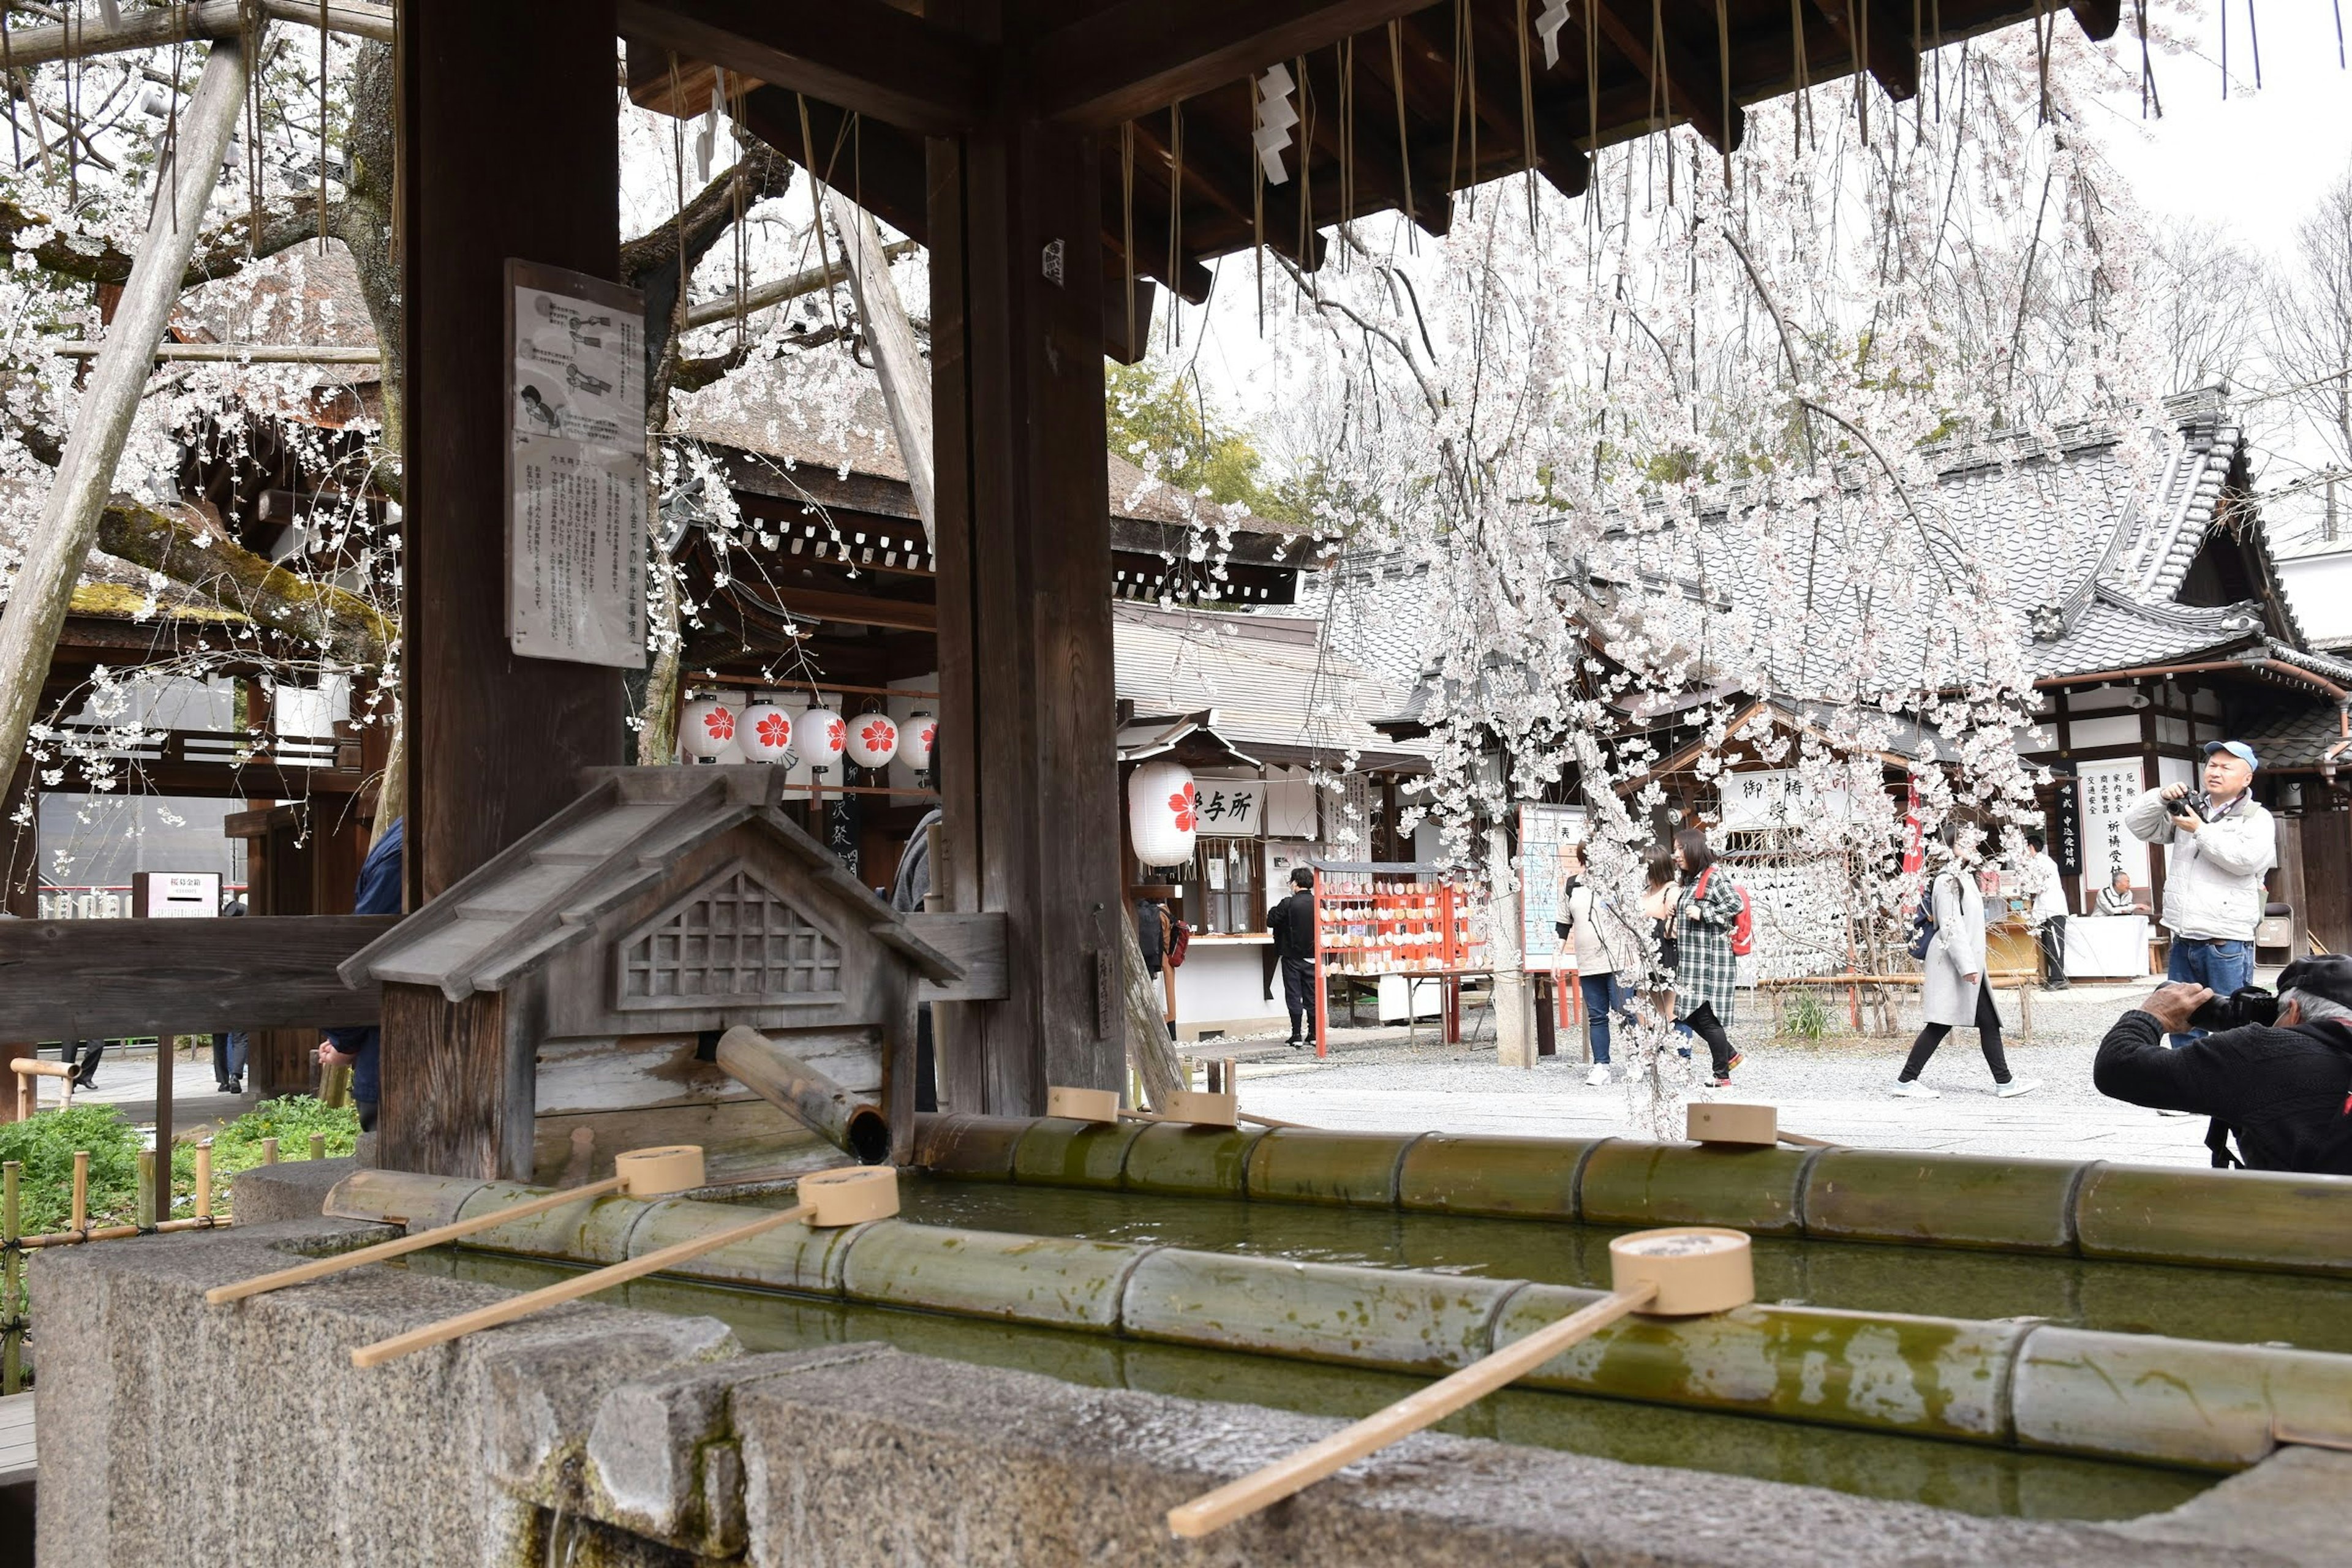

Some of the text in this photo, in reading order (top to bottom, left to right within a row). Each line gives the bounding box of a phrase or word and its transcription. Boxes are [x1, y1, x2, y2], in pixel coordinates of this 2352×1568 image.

[628, 477, 638, 637] 手水舎での禁止事項
[2087, 776, 2097, 815] 交通安全
[2100, 775, 2110, 814] 商売繁昌
[2113, 774, 2124, 813] 家内安全
[2126, 772, 2136, 808] 厄除
